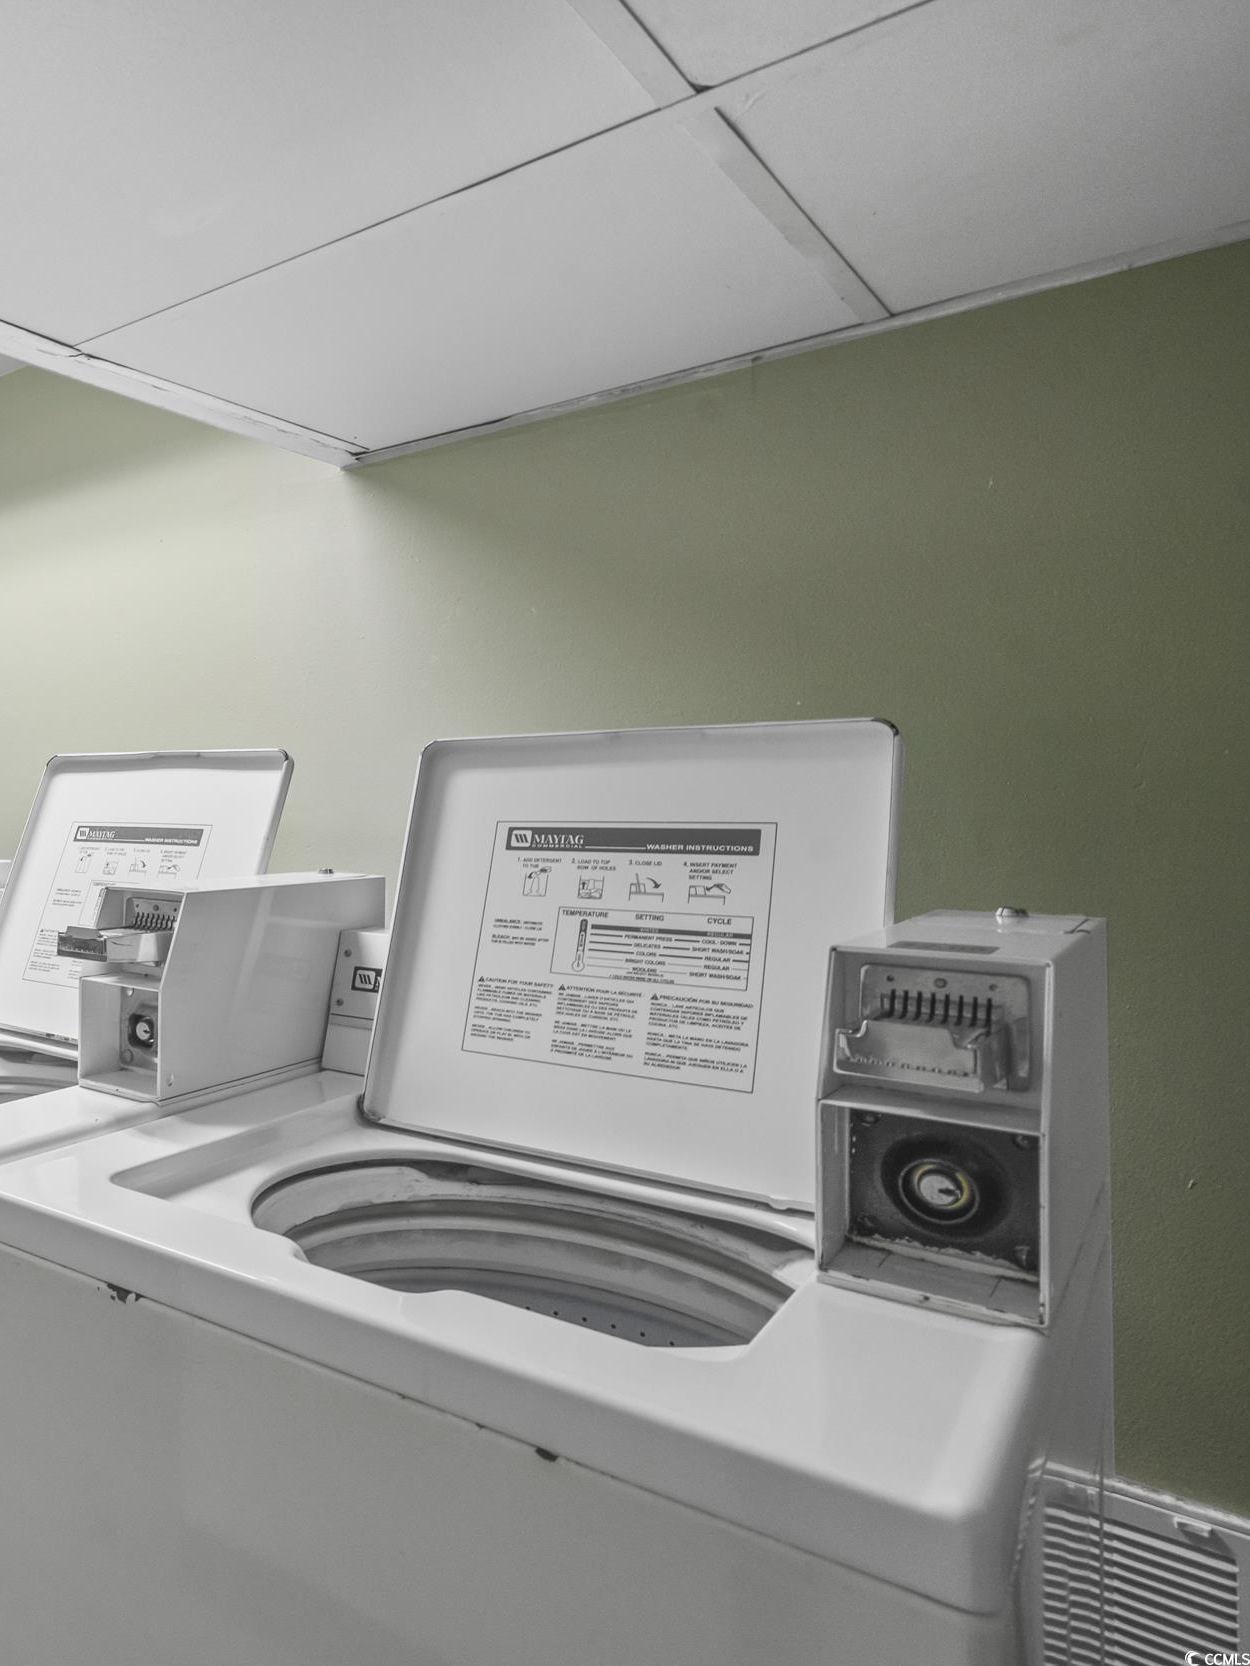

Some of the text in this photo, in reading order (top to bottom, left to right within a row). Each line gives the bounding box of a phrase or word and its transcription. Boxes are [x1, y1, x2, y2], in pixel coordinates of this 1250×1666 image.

[532, 833, 584, 844] MAYTAG
[686, 843, 754, 852] INSTRUCTIONS
[561, 909, 609, 918] TEMPERATURE
[634, 913, 664, 921] SETTING
[706, 917, 732, 925] CYCLE
